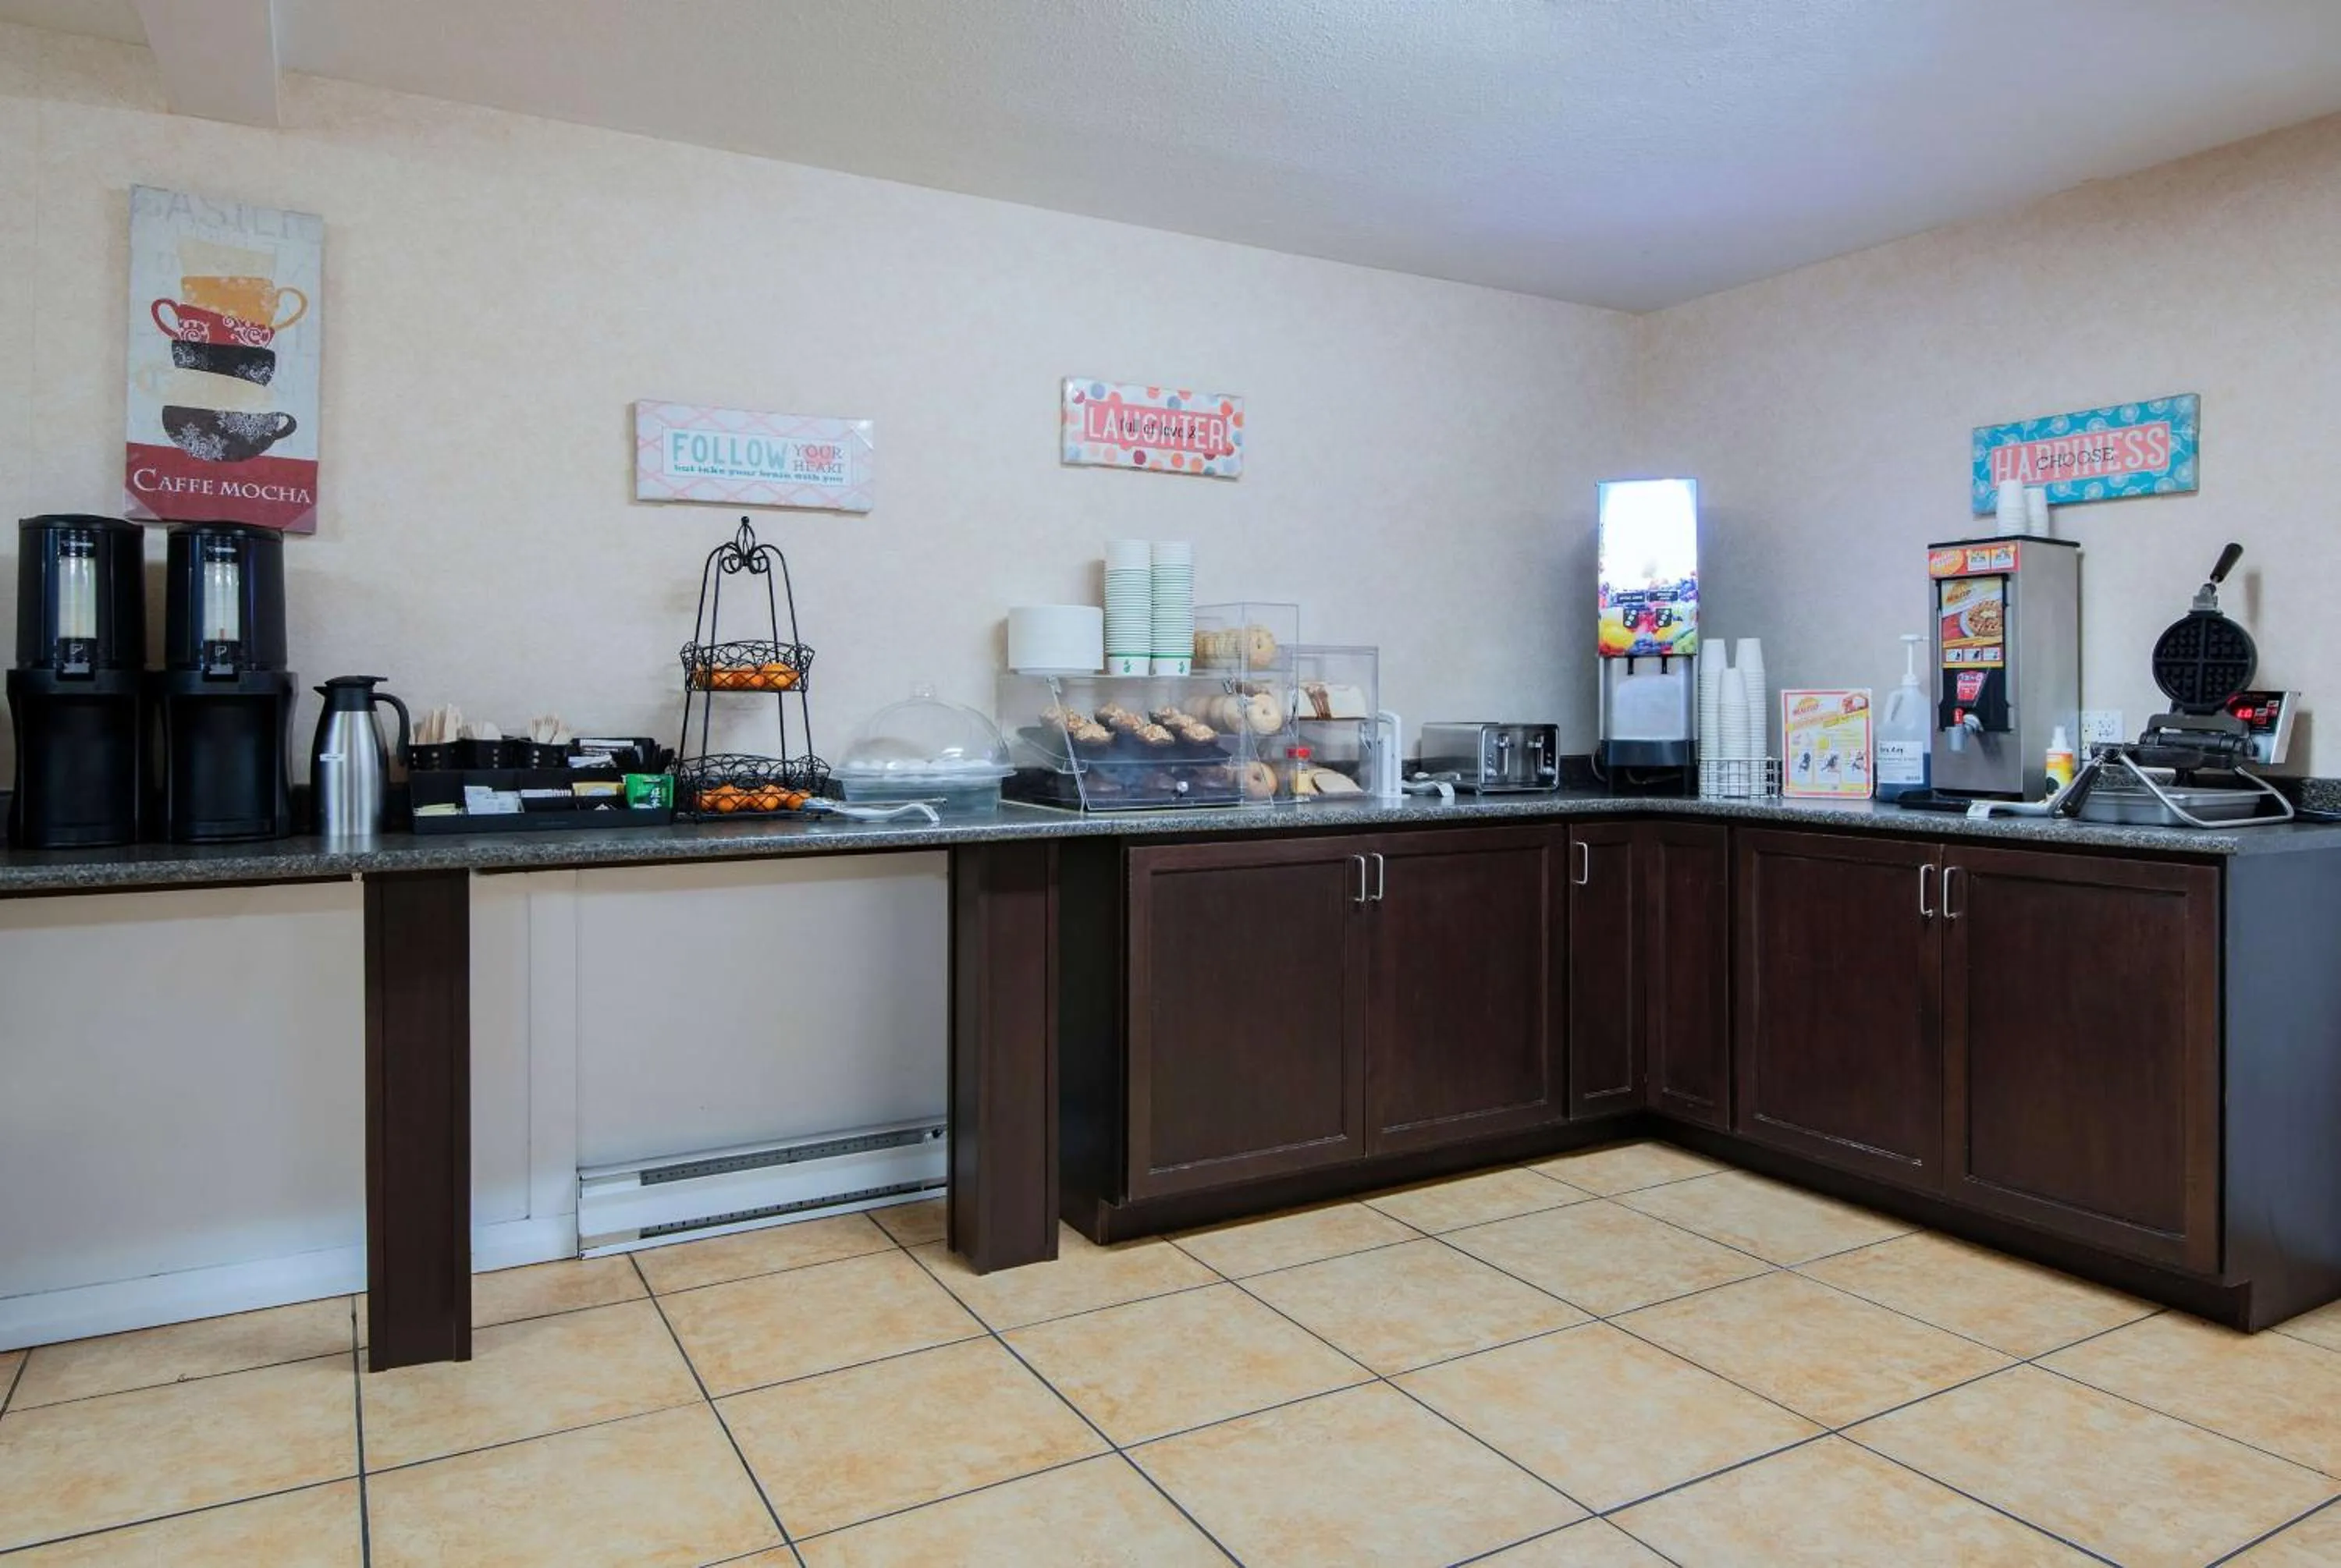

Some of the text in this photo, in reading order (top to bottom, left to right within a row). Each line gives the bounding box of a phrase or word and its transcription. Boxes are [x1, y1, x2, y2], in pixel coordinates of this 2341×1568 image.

[1088, 406, 1224, 451] LAUGHTER
[1159, 422, 1184, 438] love
[672, 433, 789, 469] FOLLOW
[793, 443, 843, 460] YOUR
[1994, 427, 2166, 486] HAPPINESS
[2036, 447, 2115, 470] CHOOSE
[793, 459, 844, 474] HEART
[133, 468, 312, 506] CAFFE MOCHA
